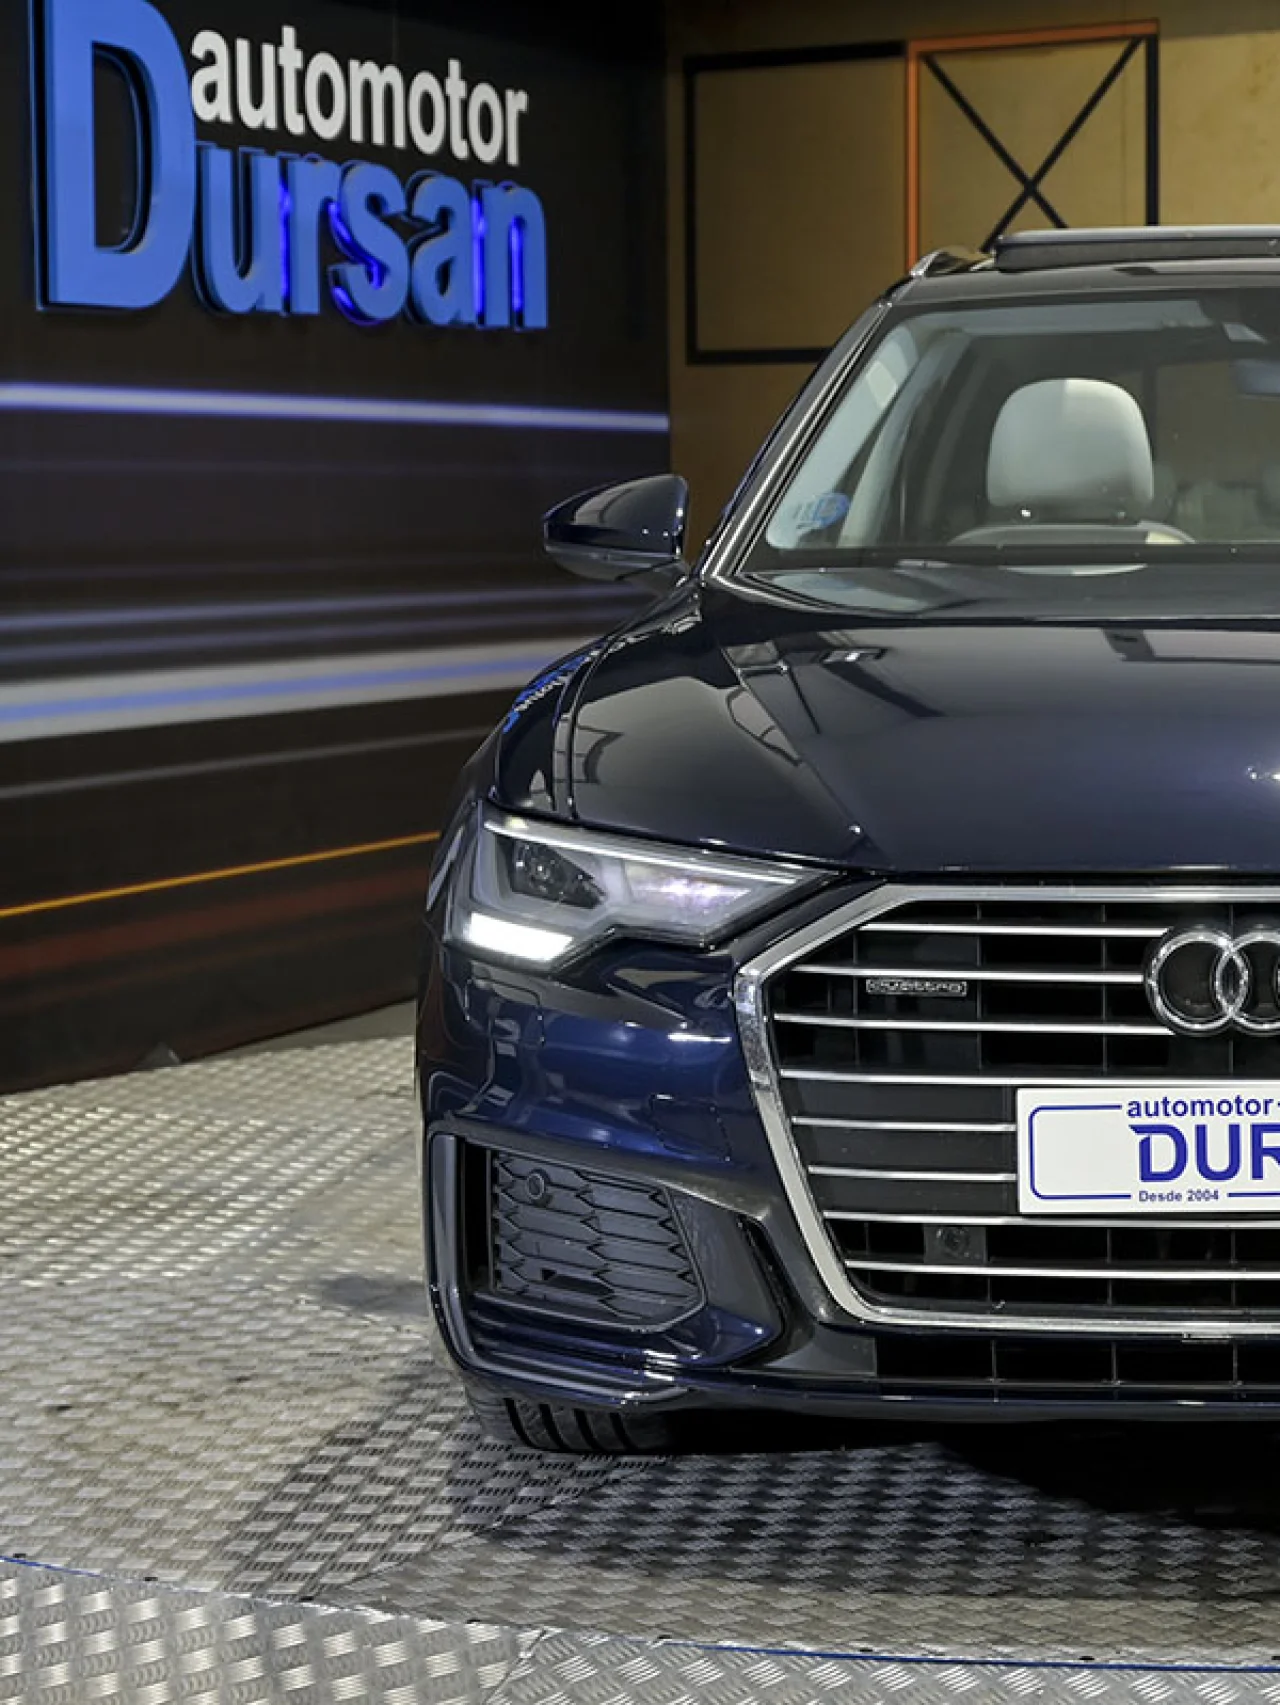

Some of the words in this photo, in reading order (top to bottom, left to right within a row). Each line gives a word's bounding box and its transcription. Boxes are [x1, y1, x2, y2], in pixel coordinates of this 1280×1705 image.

[190, 25, 528, 166] automotor
[29, 0, 548, 331] Dursan
[1127, 1094, 1275, 1118] automotor
[1138, 1189, 1183, 1202] Desde
[1187, 1189, 1219, 1202] 2004
